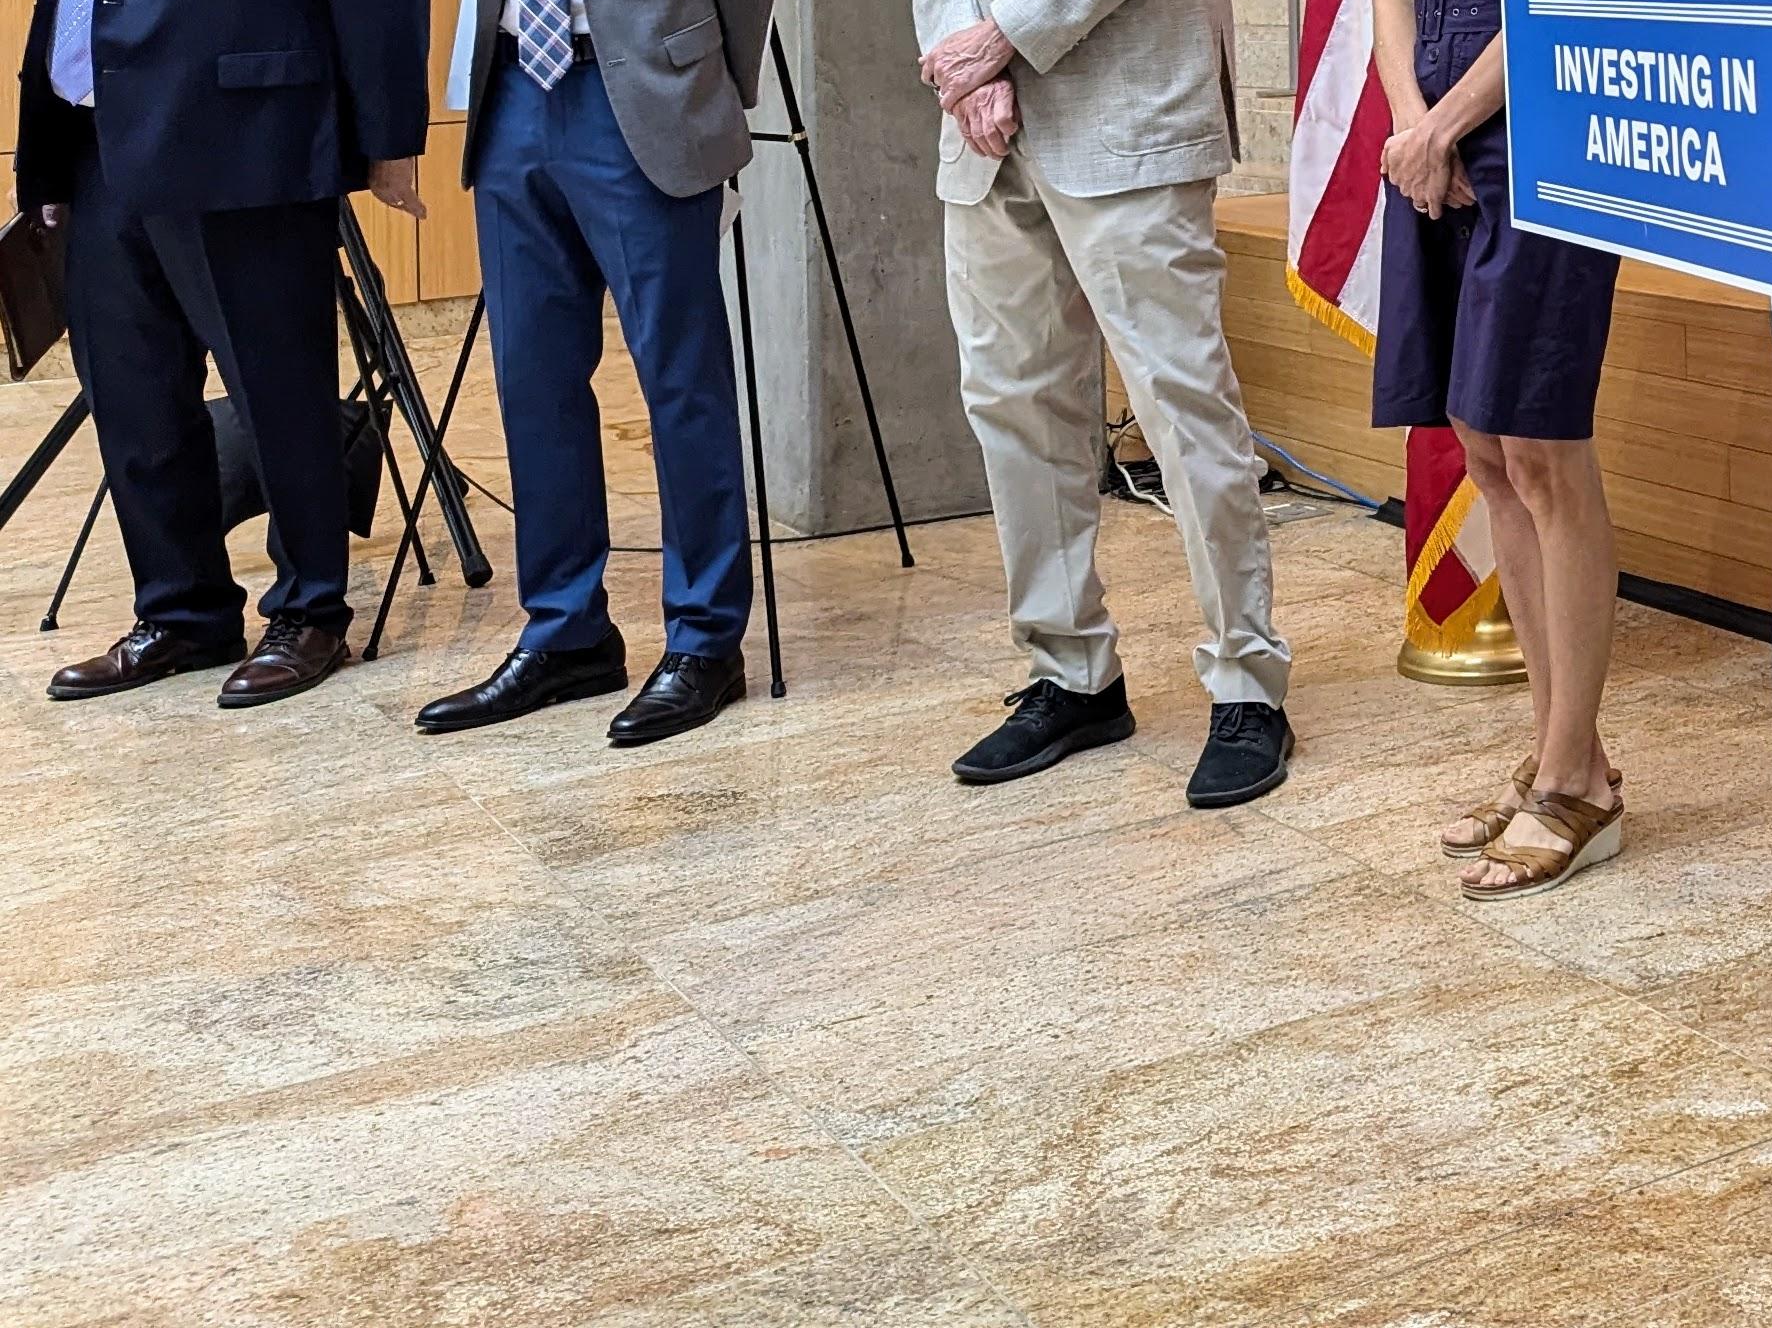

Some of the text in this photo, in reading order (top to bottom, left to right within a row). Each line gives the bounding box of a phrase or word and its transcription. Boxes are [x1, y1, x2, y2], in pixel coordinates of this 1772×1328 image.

[1554, 44, 1757, 114] INVESTING IN
[1586, 114, 1727, 186] AMERICA
